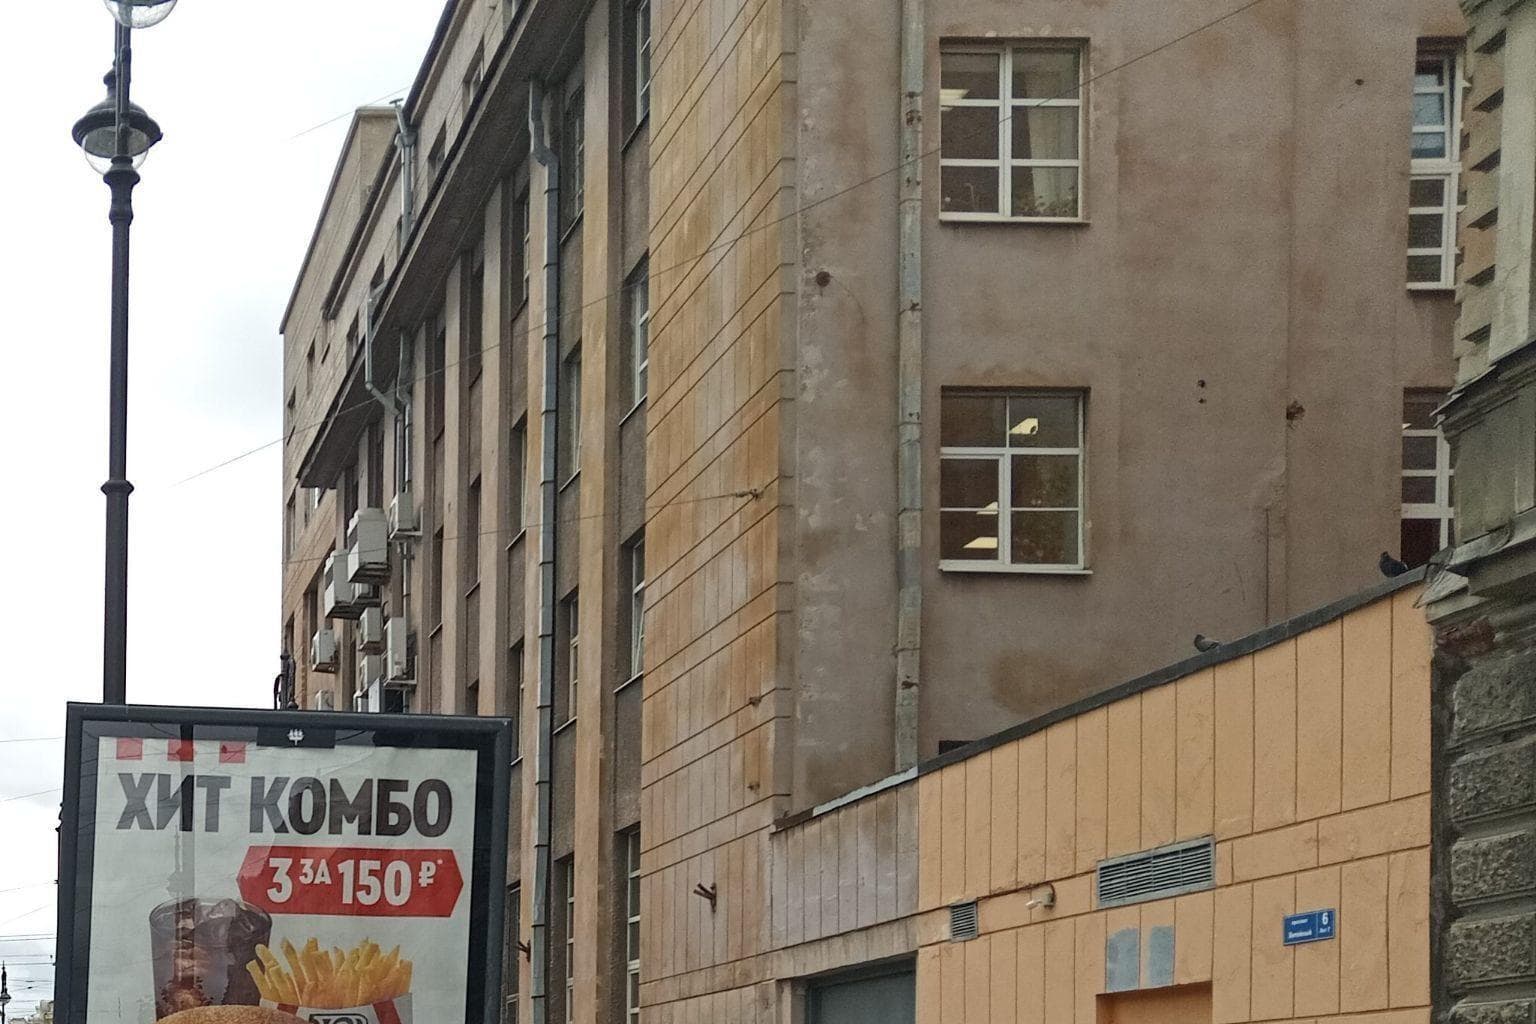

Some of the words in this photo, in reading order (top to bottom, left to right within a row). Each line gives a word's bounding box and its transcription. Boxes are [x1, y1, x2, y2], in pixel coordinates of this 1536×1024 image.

[115, 773, 232, 832] ХИТ
[249, 776, 453, 837] КОМБО
[267, 857, 293, 903] 3
[299, 858, 332, 885] ЗА
[338, 859, 413, 907] 150
[1322, 911, 1330, 925] 6
